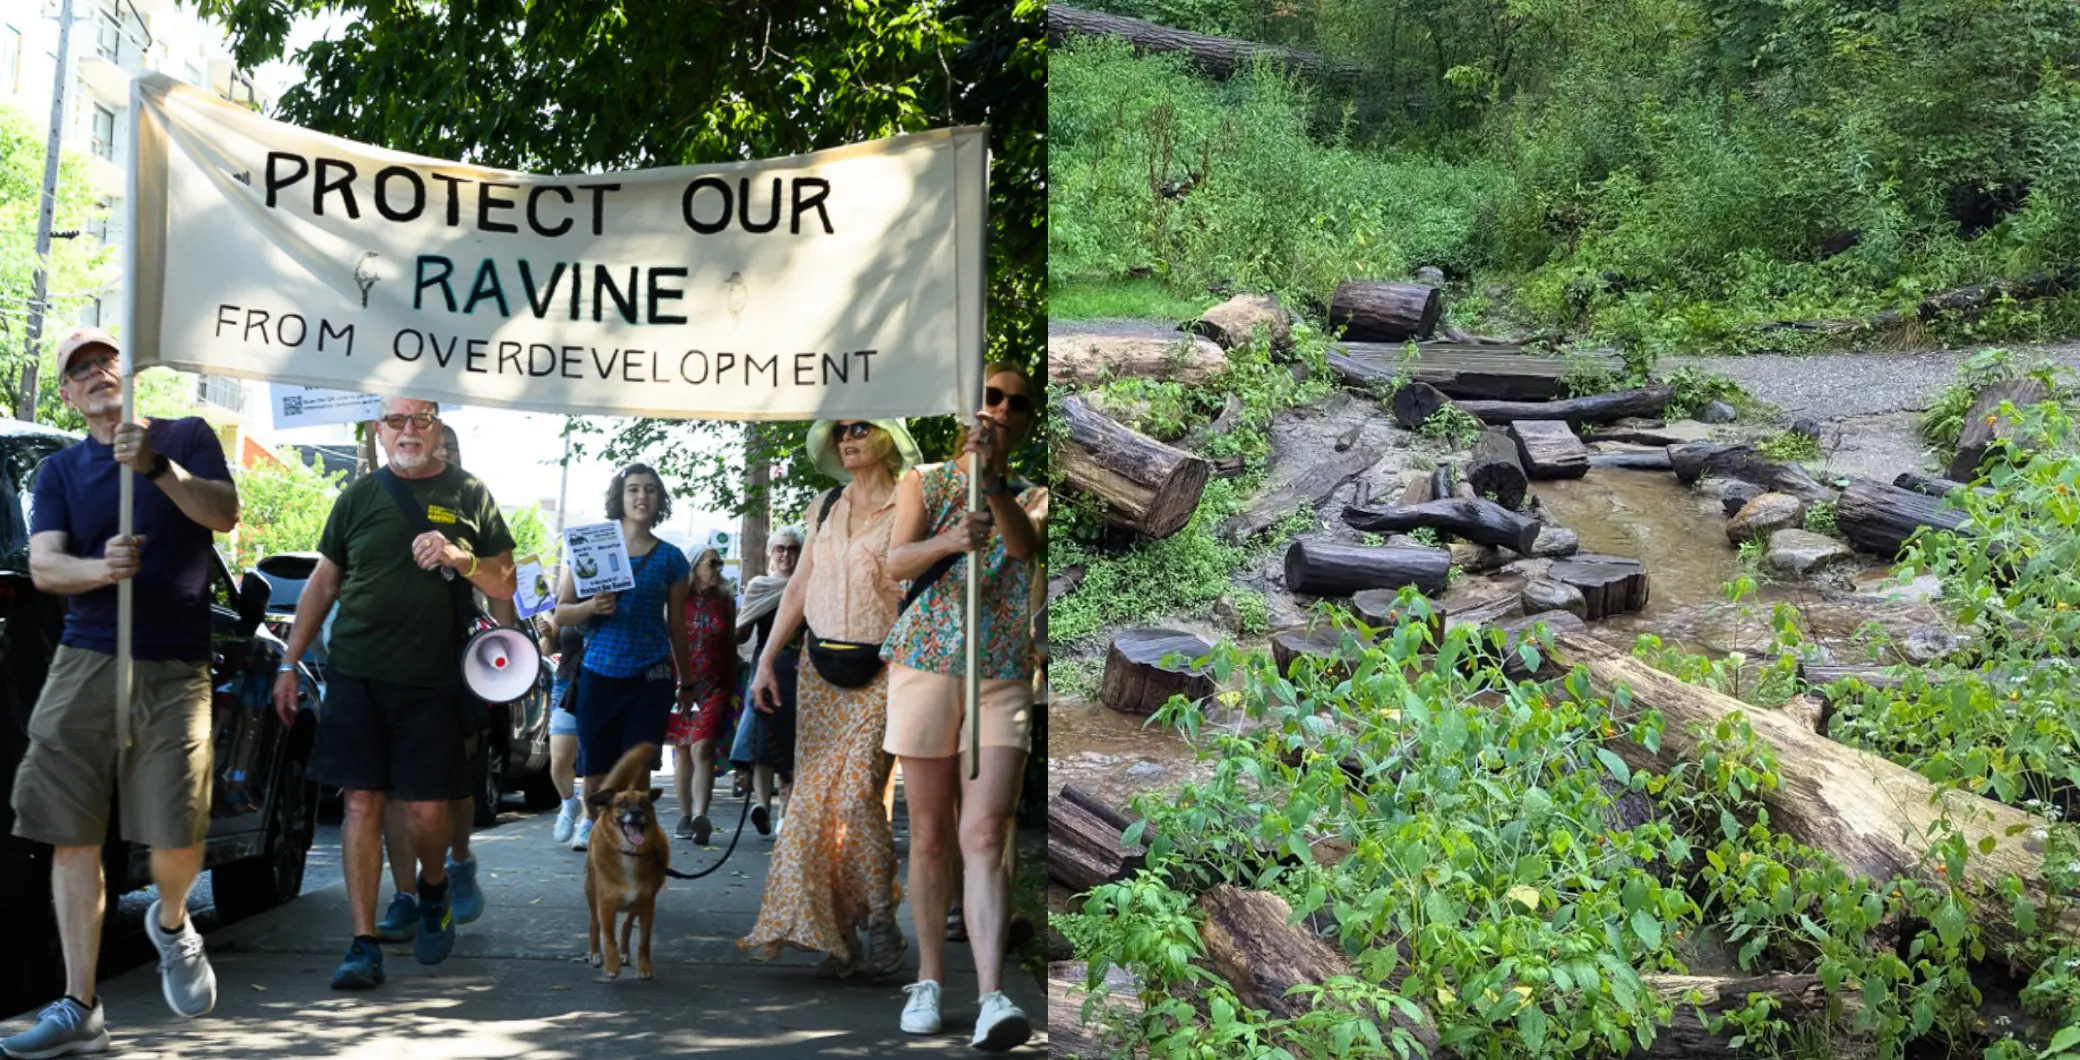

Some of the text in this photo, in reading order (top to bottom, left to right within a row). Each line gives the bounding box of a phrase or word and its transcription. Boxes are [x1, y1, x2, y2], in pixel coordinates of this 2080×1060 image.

[265, 151, 834, 238] PROTECT OUR
[413, 255, 688, 325] RAVINE
[216, 304, 878, 387] FROM OVERDEVELOPMENT
